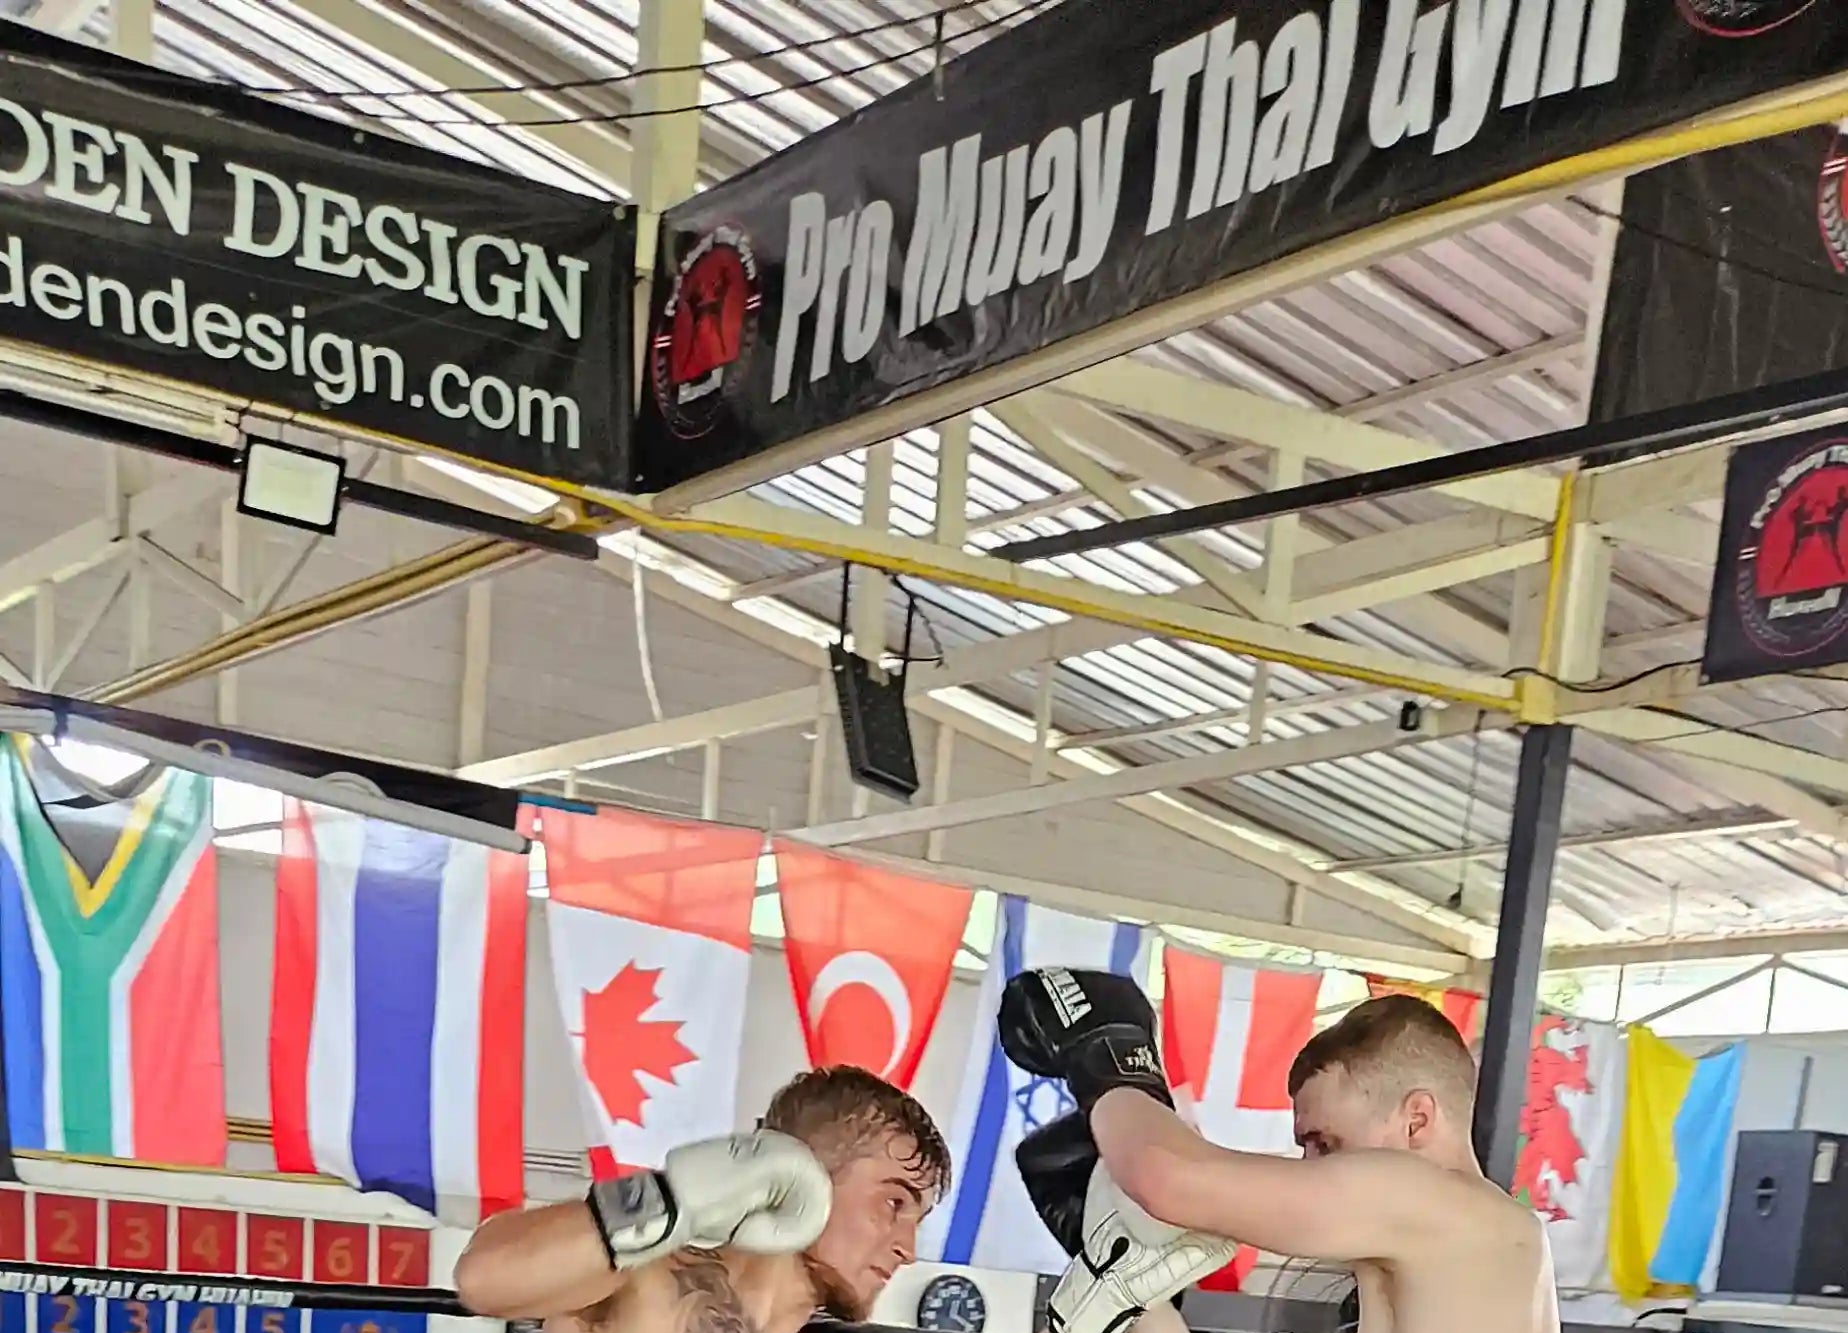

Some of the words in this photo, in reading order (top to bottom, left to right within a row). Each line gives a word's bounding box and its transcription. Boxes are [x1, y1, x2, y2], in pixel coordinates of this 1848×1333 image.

[224, 161, 590, 340] DESIGN
[771, 192, 894, 404] Pro
[900, 99, 1134, 340] Muay
[1145, 0, 1360, 236] Thai
[50, 1209, 80, 1256] 2
[124, 1217, 152, 1260] 3
[191, 1224, 220, 1266] 4
[261, 1229, 290, 1272] 5
[326, 1237, 354, 1278] 6
[388, 1241, 416, 1281] 7
